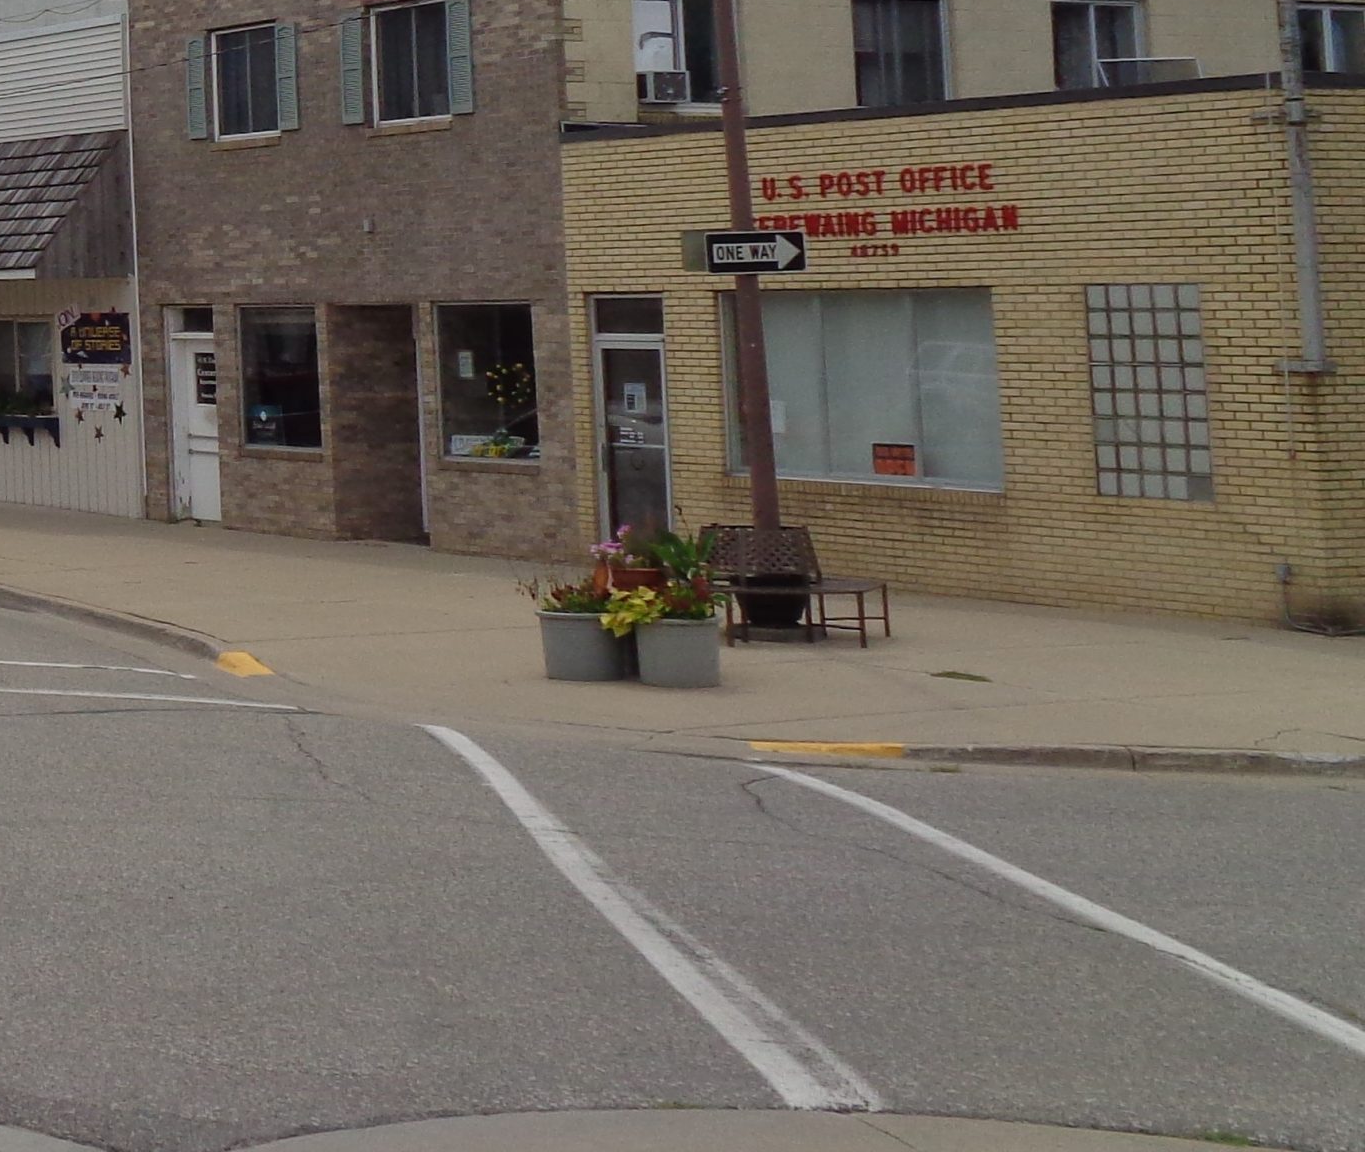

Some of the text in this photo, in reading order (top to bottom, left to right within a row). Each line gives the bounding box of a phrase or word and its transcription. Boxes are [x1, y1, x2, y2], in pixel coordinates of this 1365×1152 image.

[818, 170, 887, 198] POST
[899, 163, 995, 193] OFFICE
[891, 204, 1019, 235] MICHIGAN
[716, 245, 777, 260] ONE WAY
